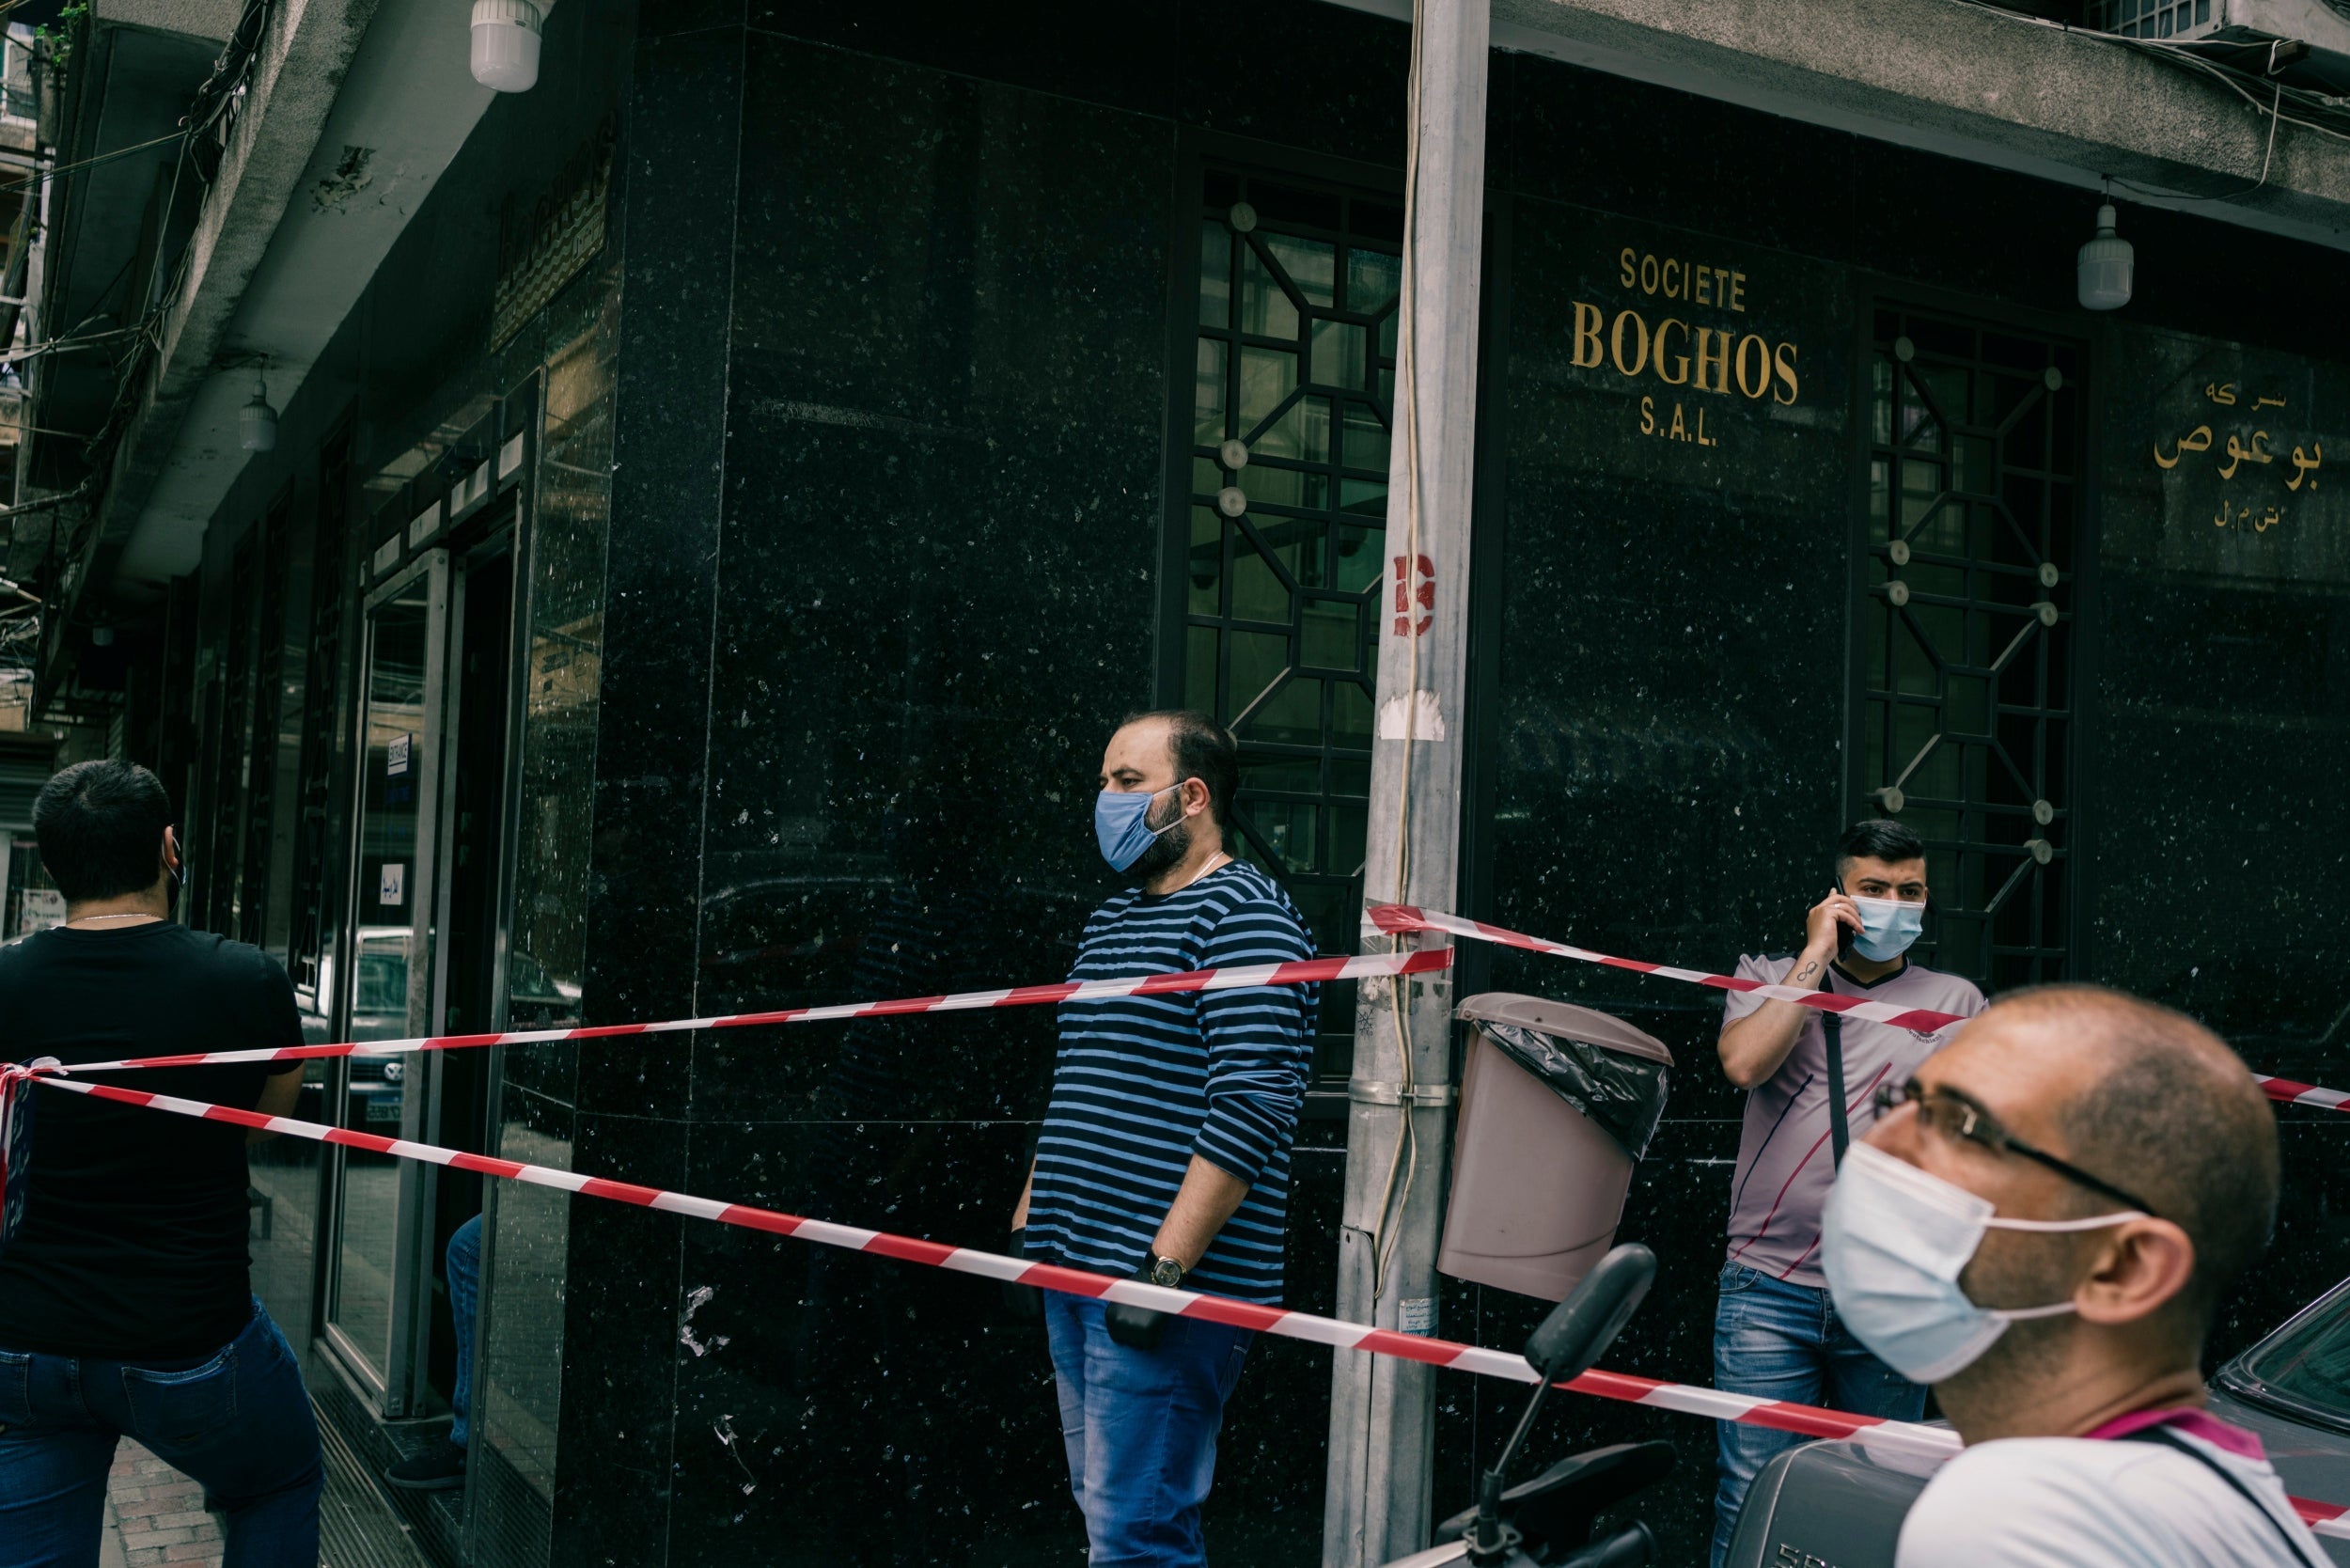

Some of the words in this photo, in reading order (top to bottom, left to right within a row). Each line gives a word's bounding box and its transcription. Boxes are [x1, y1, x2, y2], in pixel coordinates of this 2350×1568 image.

[1620, 247, 1746, 312] SOCIETE
[1569, 301, 1798, 405] BOGHOS
[1640, 396, 1716, 447] S.A.L.
[389, 741, 407, 762] ENTRANCE
